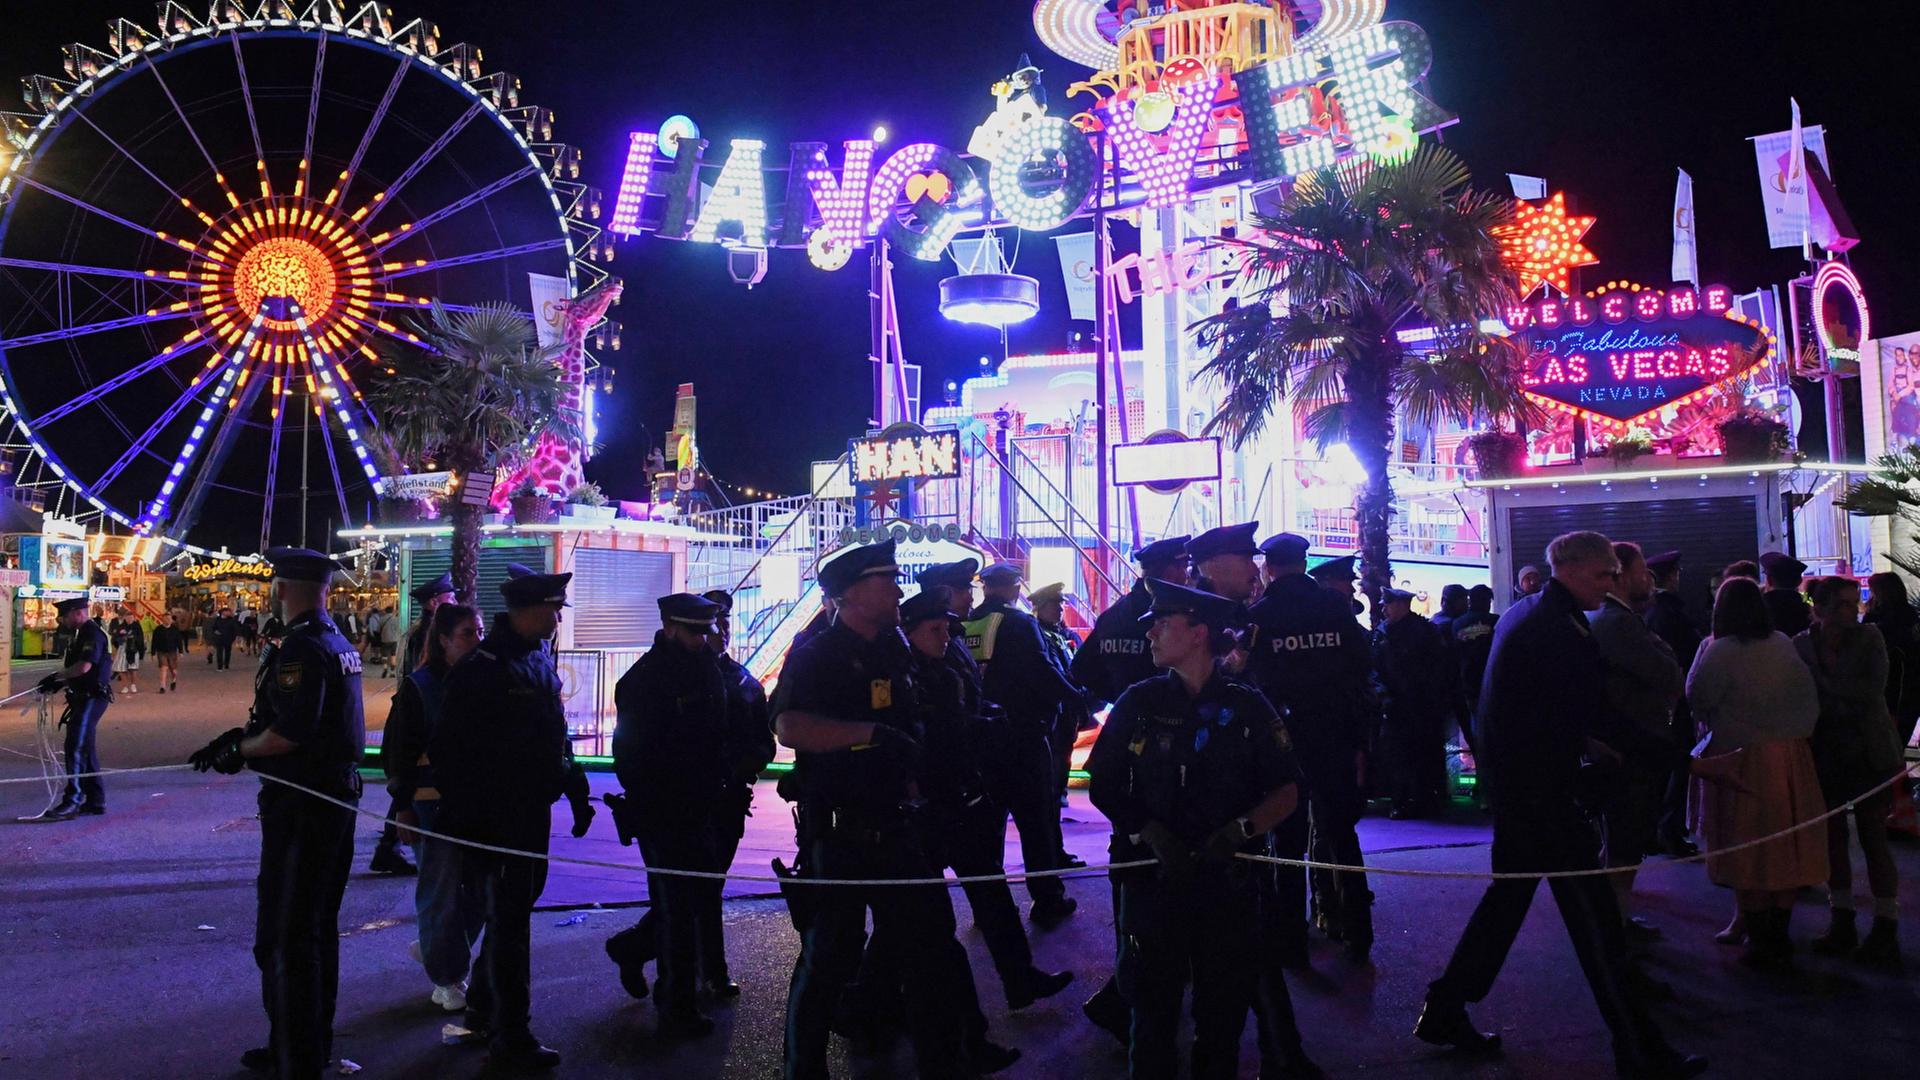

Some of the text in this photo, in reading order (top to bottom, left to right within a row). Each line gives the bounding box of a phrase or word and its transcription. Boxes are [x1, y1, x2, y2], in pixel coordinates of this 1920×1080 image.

[610, 20, 1460, 263] HANGOVER
[1104, 240, 1210, 304] THE
[1506, 288, 1727, 326] WELCOME
[1560, 328, 1680, 358] Fabulous
[1522, 347, 1732, 386] LAS VEGAS
[1579, 385, 1666, 402] NEVADA
[857, 434, 955, 481] HAN
[841, 527, 957, 543] WELCOME
[1272, 632, 1341, 653] POLIZEI
